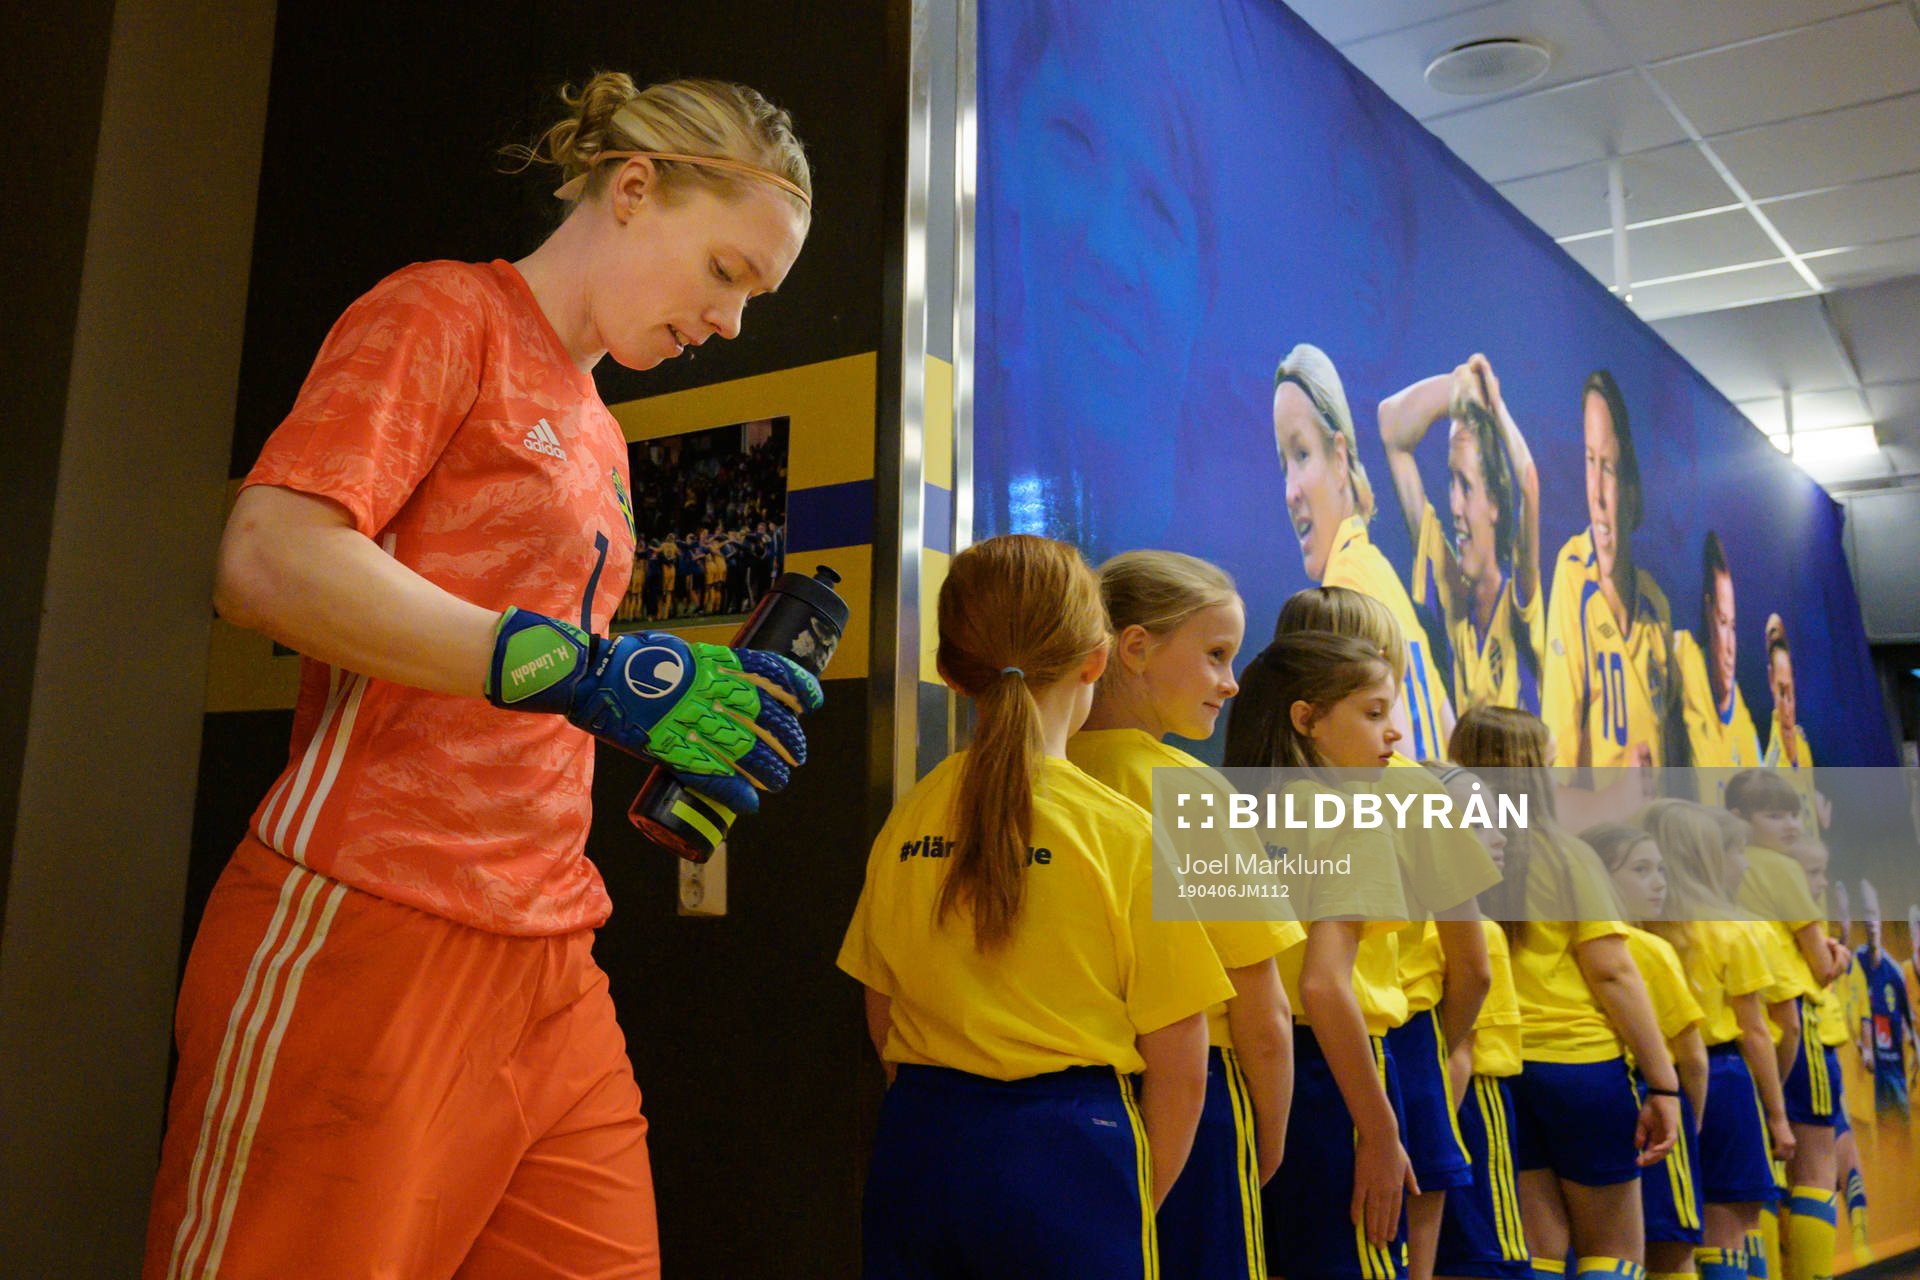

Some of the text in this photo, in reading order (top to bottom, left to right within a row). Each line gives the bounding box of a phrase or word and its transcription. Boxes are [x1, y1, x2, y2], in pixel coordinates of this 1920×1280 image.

[511, 653, 555, 686] Lindahl
[553, 645, 570, 661] H.
[1597, 651, 1628, 747] 10
